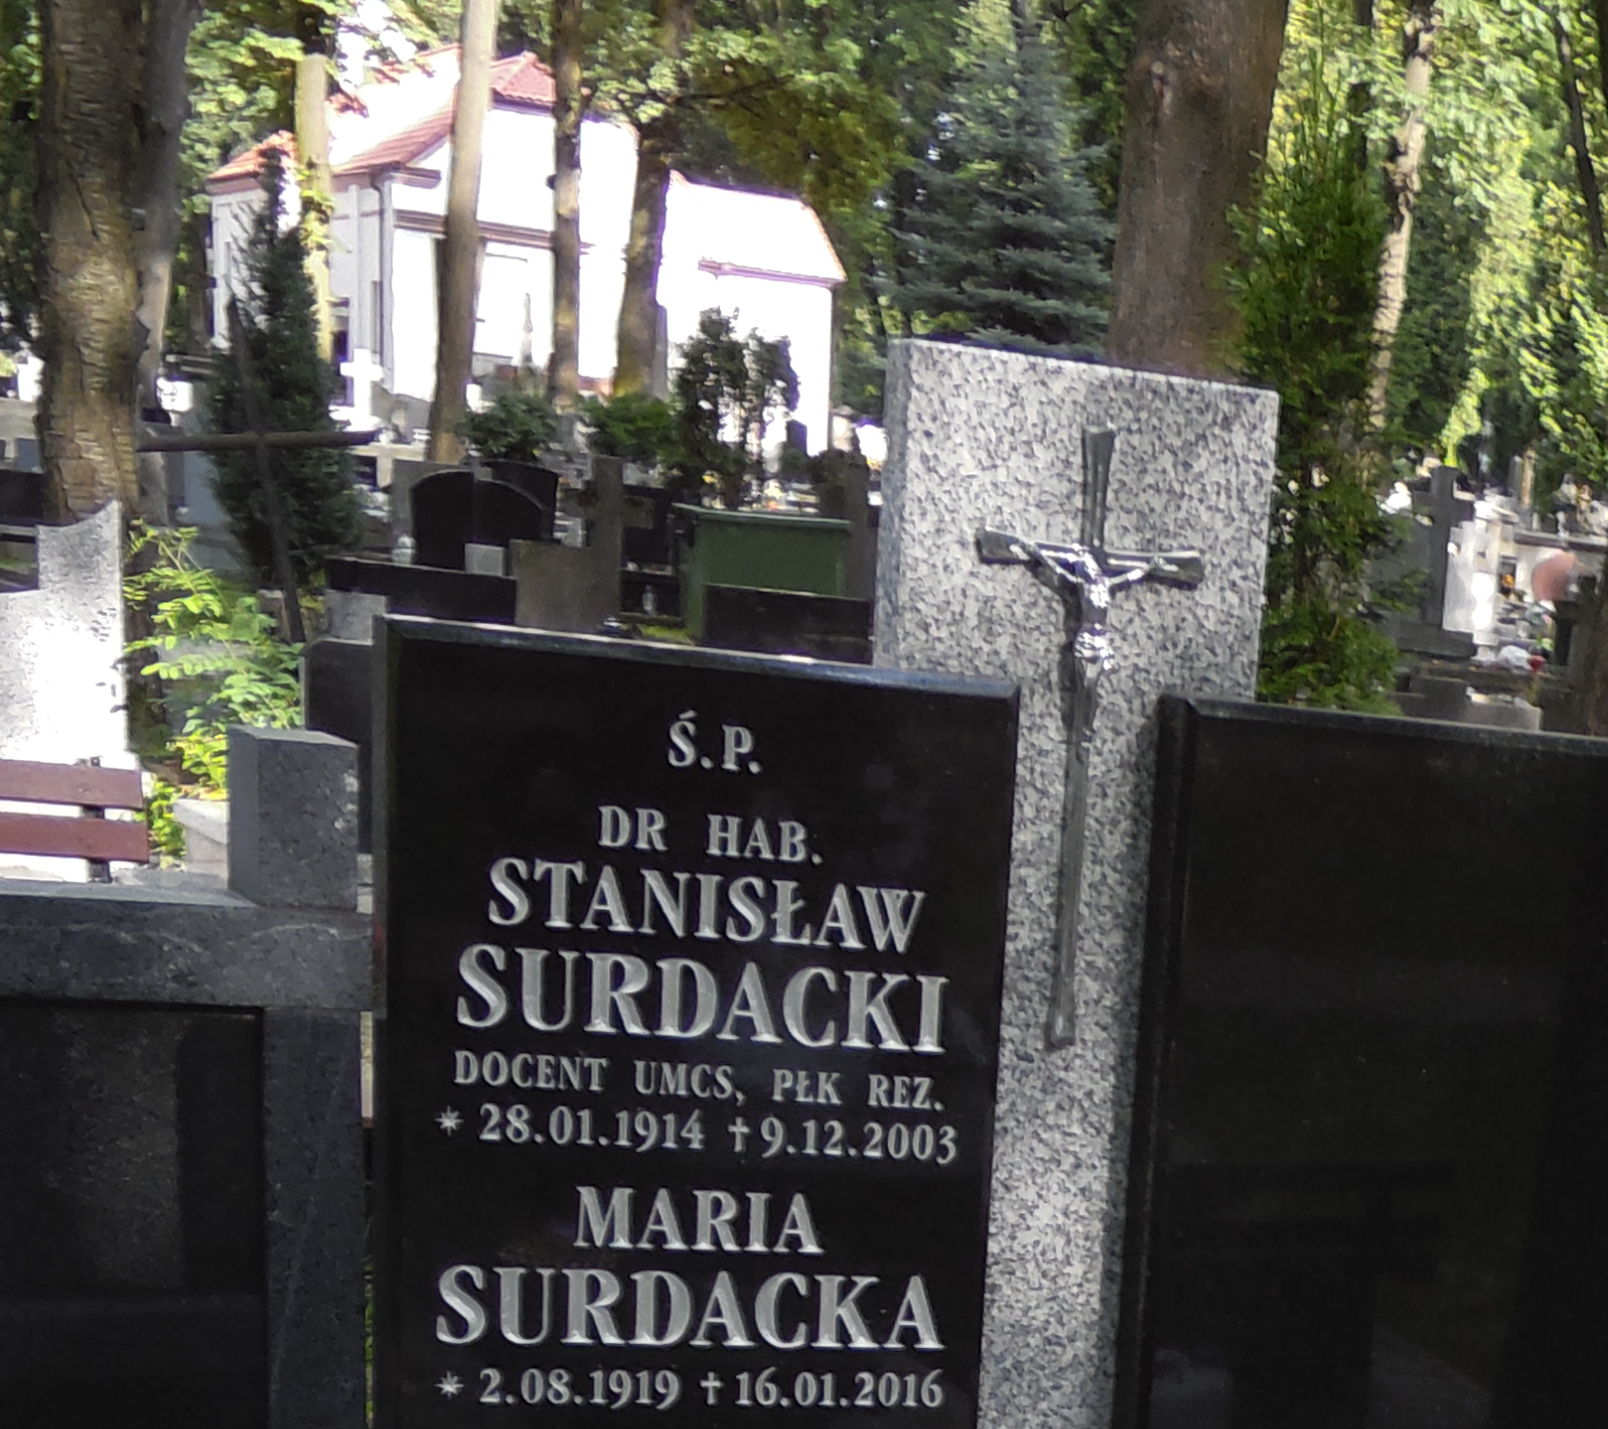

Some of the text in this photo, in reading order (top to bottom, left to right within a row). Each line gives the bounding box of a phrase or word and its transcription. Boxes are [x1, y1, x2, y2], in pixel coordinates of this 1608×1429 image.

[599, 806, 821, 864] DR HAB.
[487, 857, 925, 953] STANISŁAW
[455, 942, 949, 1055] SURDACKI
[455, 1051, 607, 1091] DOCENT
[773, 1069, 842, 1105] PŁK
[480, 1103, 956, 1164] 28.01.1914 9.12.2003
[574, 1187, 824, 1254] MARIA
[437, 1265, 944, 1349] SURDACKA
[480, 1367, 943, 1409] 2.08.1919 16.01.2016
